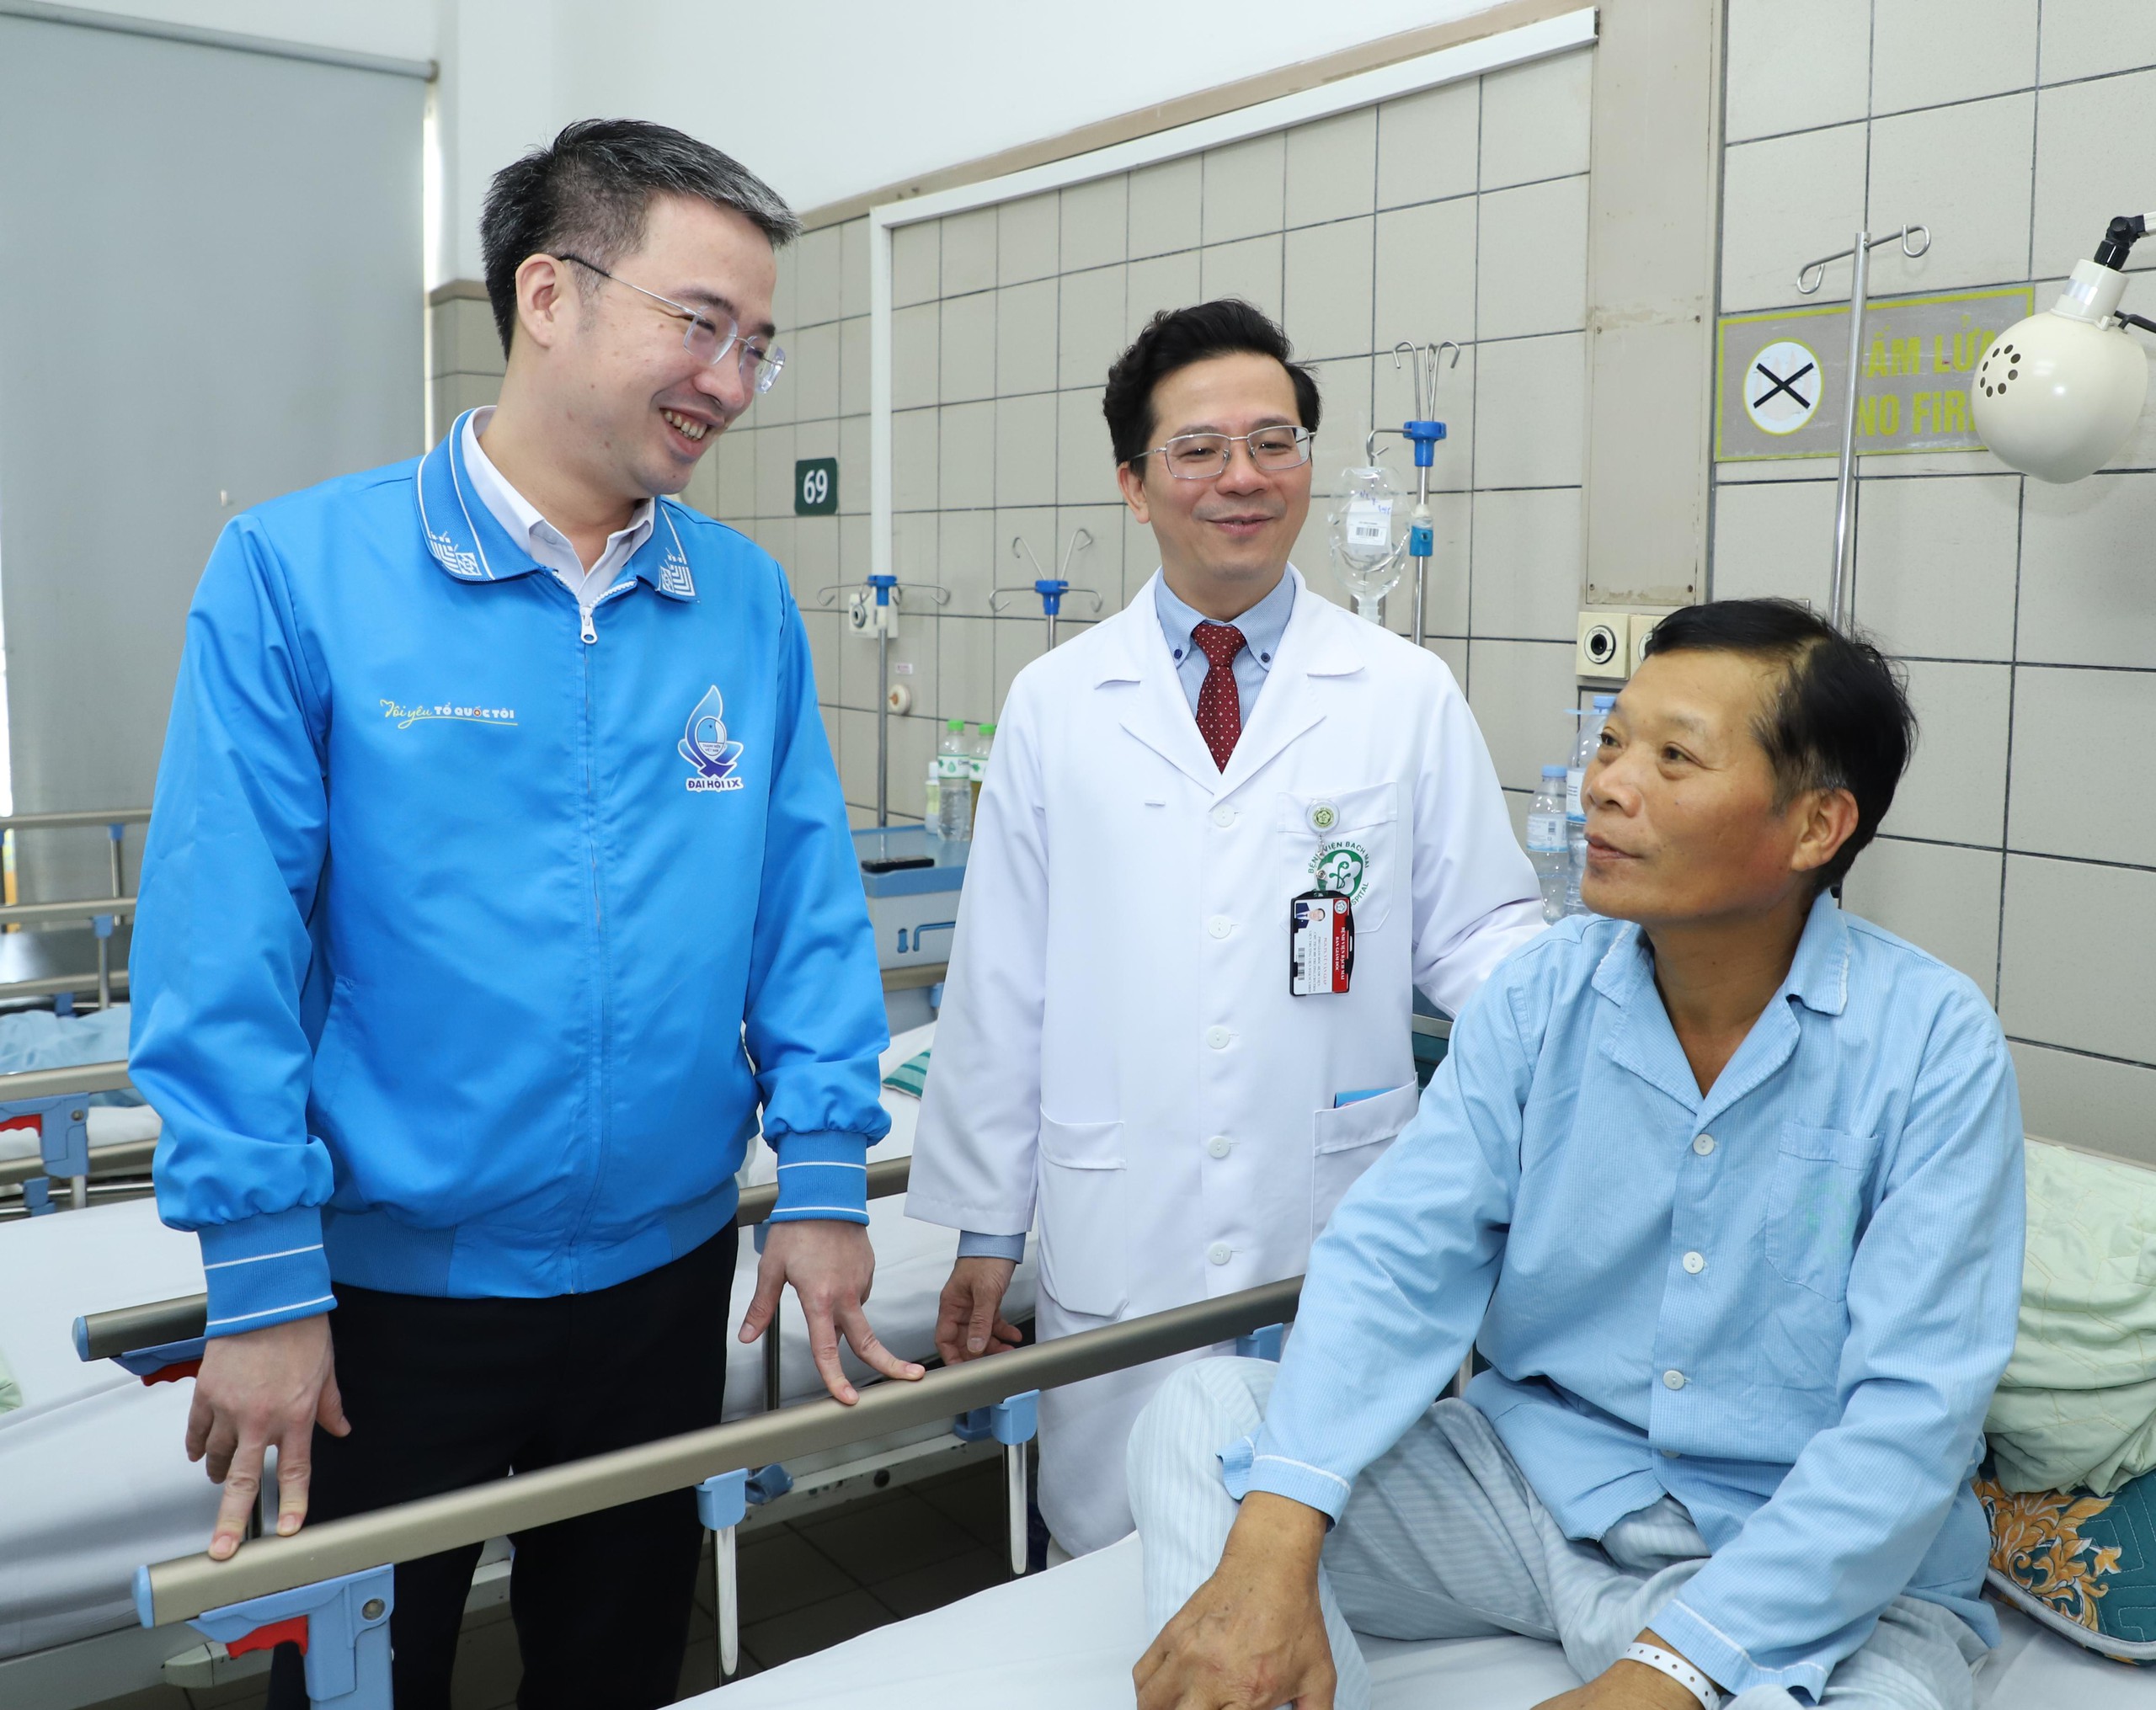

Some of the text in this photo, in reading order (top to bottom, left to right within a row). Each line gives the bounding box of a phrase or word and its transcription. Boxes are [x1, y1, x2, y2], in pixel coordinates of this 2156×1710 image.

[1860, 324, 1921, 378] ẤM
[1856, 393, 1901, 437] NO
[803, 468, 829, 504] 69
[434, 701, 452, 716] TỔ
[454, 706, 491, 717] QUỐC
[491, 707, 515, 719] TÔI
[688, 778, 740, 791] ĐẠI HỘI IX
[1308, 852, 1320, 874] BỆN
[1345, 841, 1366, 855] BẠCH
[1351, 882, 1369, 906] SPITAL
